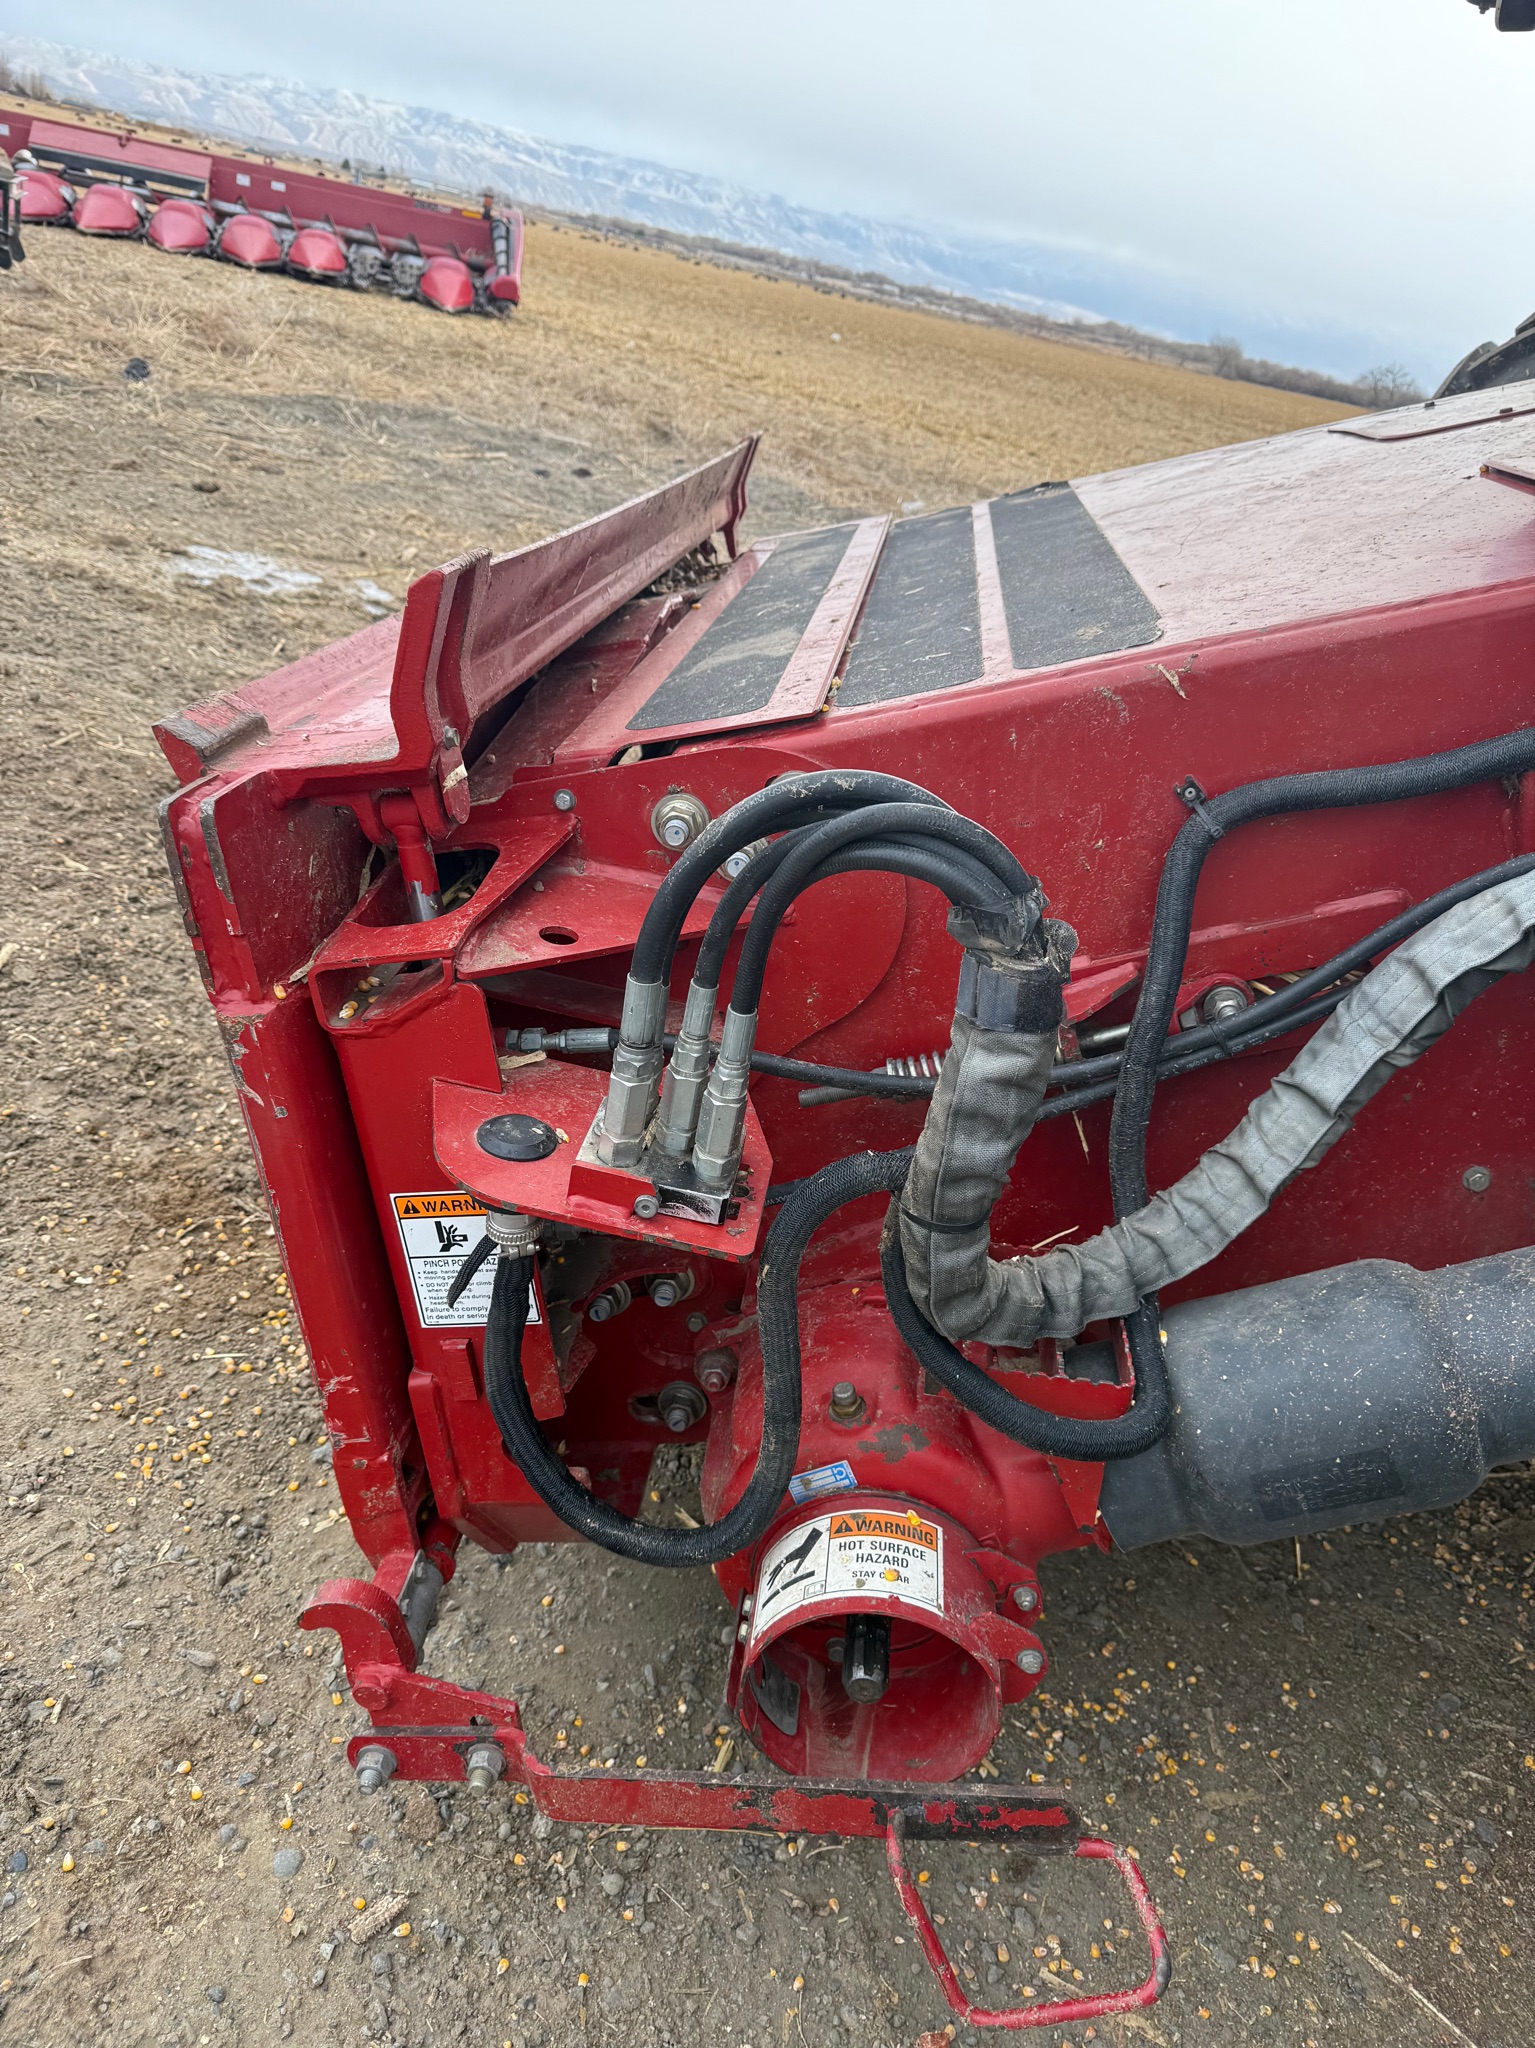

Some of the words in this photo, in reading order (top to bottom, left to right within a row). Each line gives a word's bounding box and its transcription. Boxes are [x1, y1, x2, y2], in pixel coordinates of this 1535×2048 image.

[424, 1259, 449, 1267] PINCH
[856, 1519, 933, 1546] WARNING
[839, 1540, 865, 1552] HOT
[870, 1540, 927, 1561] SURFACE
[856, 1553, 909, 1568] HAZARD
[879, 1571, 910, 1584] CAR
